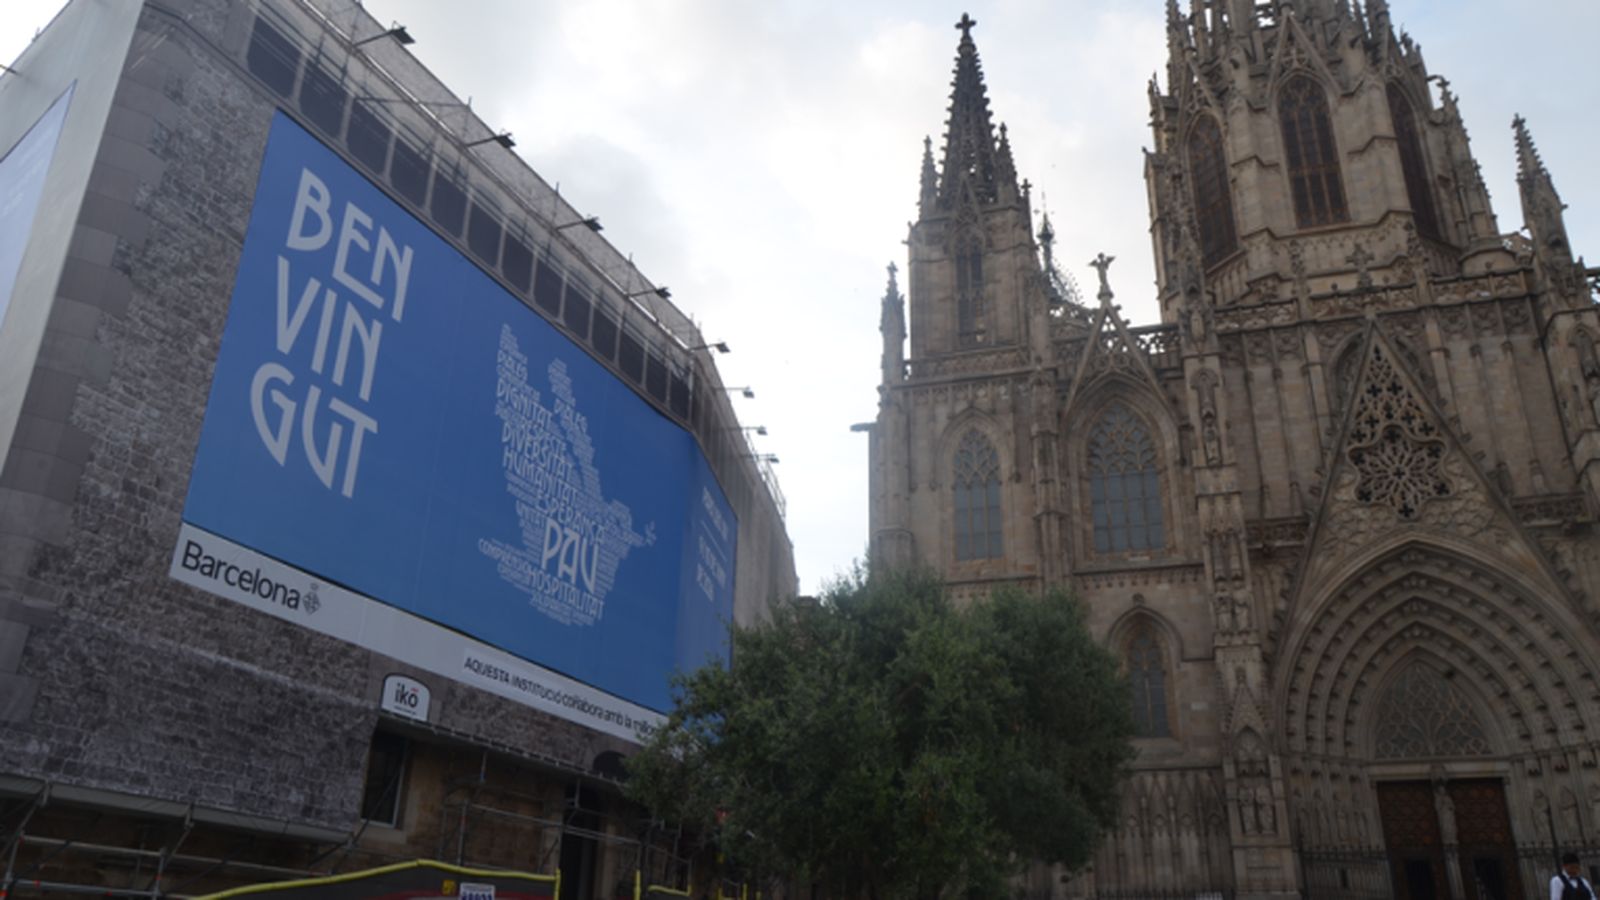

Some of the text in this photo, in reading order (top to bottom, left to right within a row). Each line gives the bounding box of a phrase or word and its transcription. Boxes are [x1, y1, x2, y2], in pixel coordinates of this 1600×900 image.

[286, 167, 414, 323] BEN
[276, 254, 383, 402] VIN
[251, 362, 378, 499] GUT
[496, 376, 552, 431] DIGNITAT
[501, 420, 572, 482] DIVERSITAT
[501, 444, 577, 508] HUMANITAT
[181, 539, 300, 610] Barcelona
[540, 516, 599, 594] PAU
[527, 565, 603, 620] HOSPITALITAT
[464, 656, 510, 686] AQUESTA
